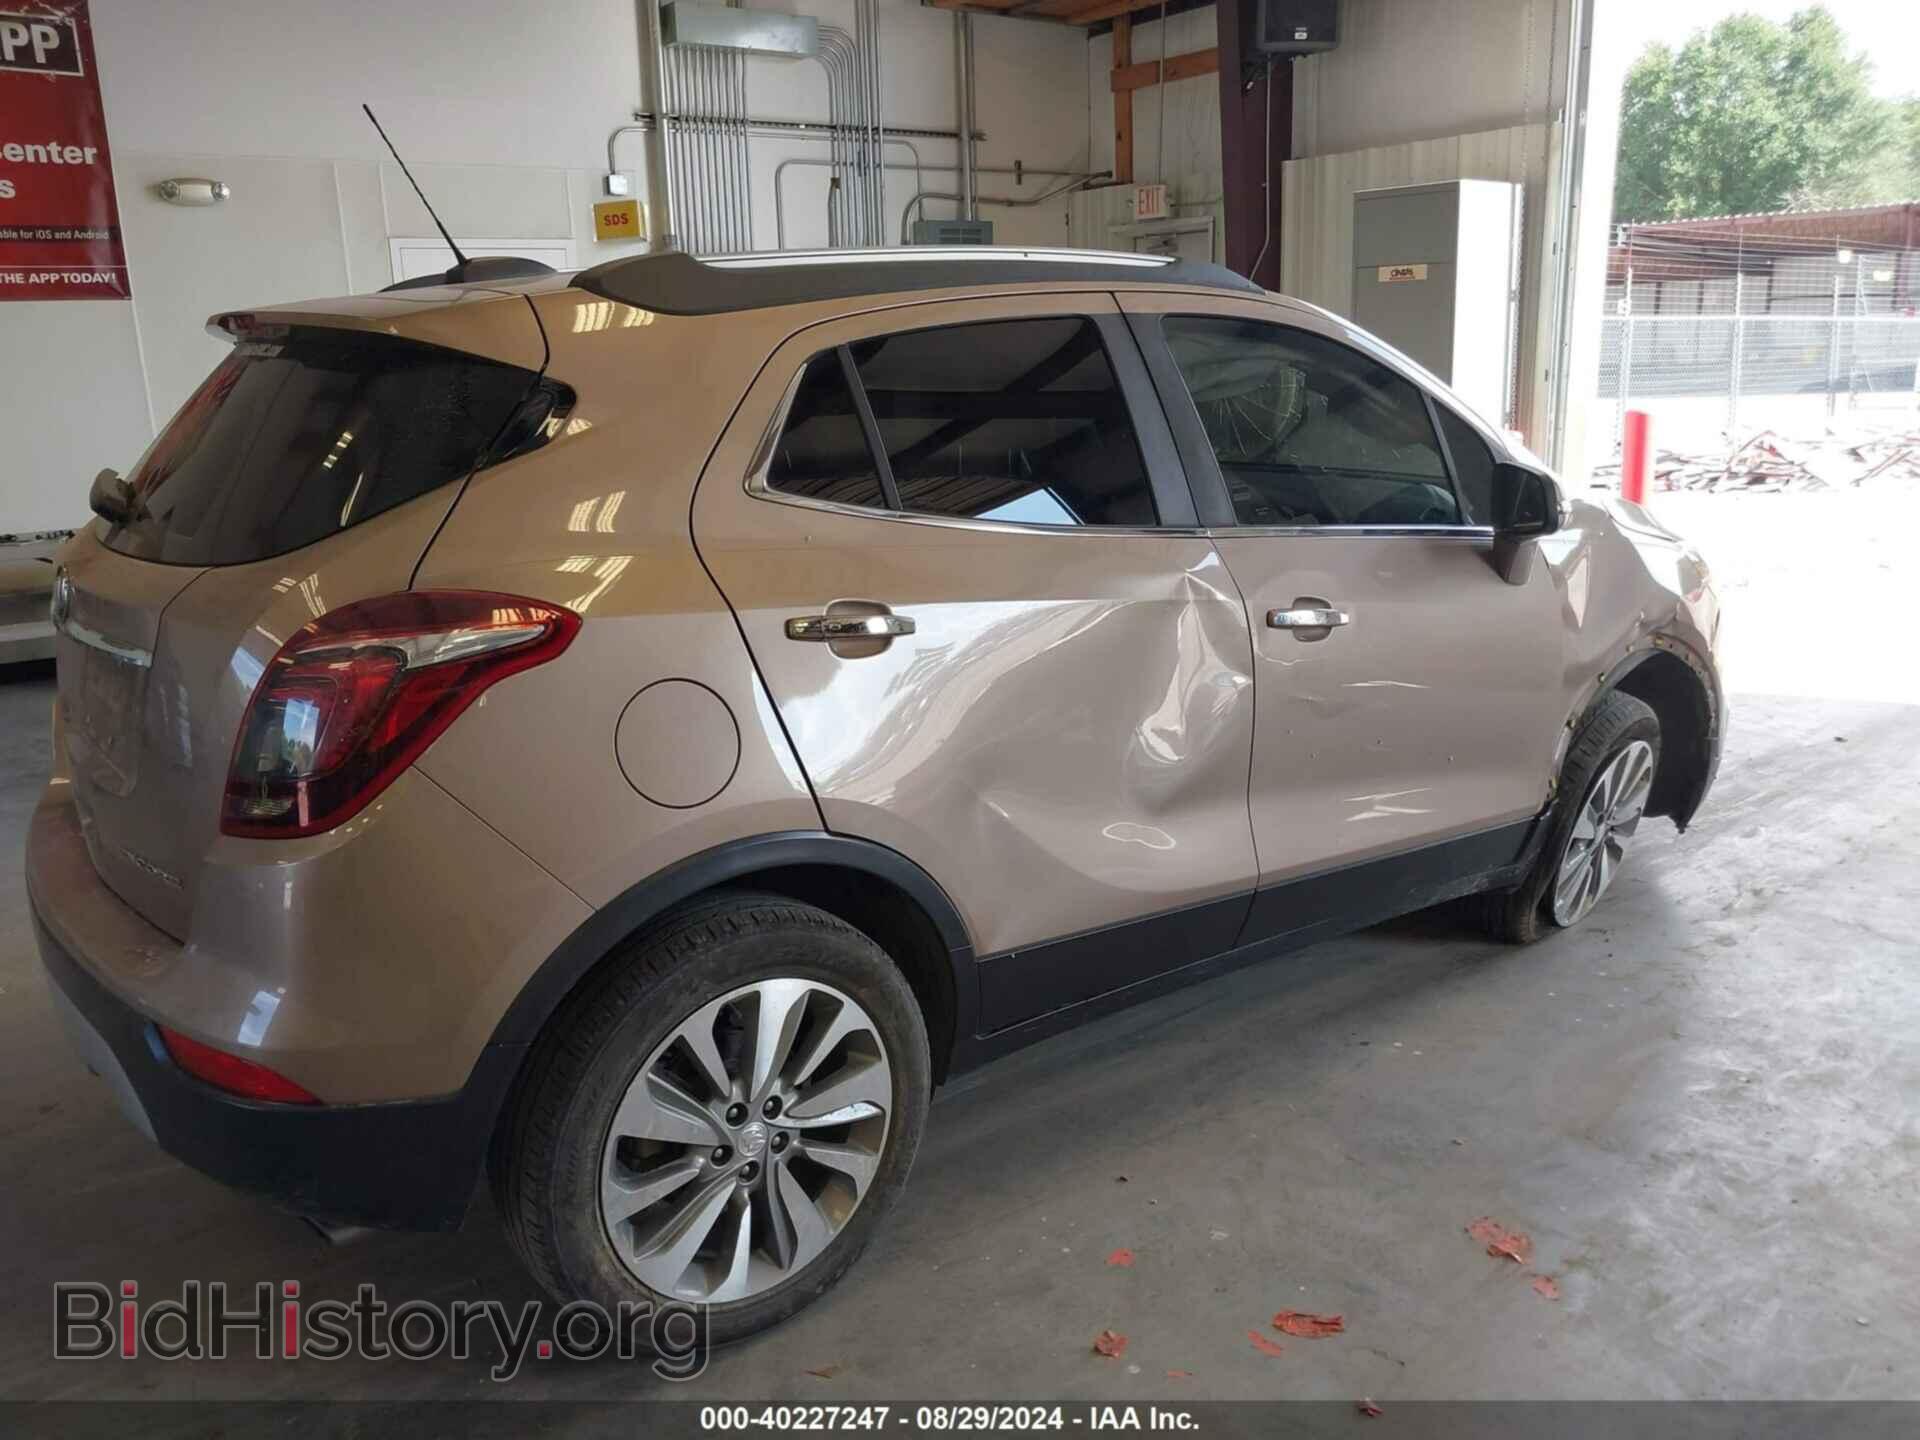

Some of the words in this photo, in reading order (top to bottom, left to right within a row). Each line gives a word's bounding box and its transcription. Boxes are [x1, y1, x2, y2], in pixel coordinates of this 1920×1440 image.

[0, 22, 60, 63] PP
[0, 142, 97, 165] enter
[1138, 187, 1162, 215] EXIT
[604, 213, 629, 226] SDS
[20, 230, 33, 240] for
[35, 229, 52, 240] iOS
[54, 230, 71, 240] and
[73, 230, 109, 240] Android
[0, 272, 25, 284] THE
[28, 272, 60, 284] APP
[60, 272, 116, 284] TODAY!
